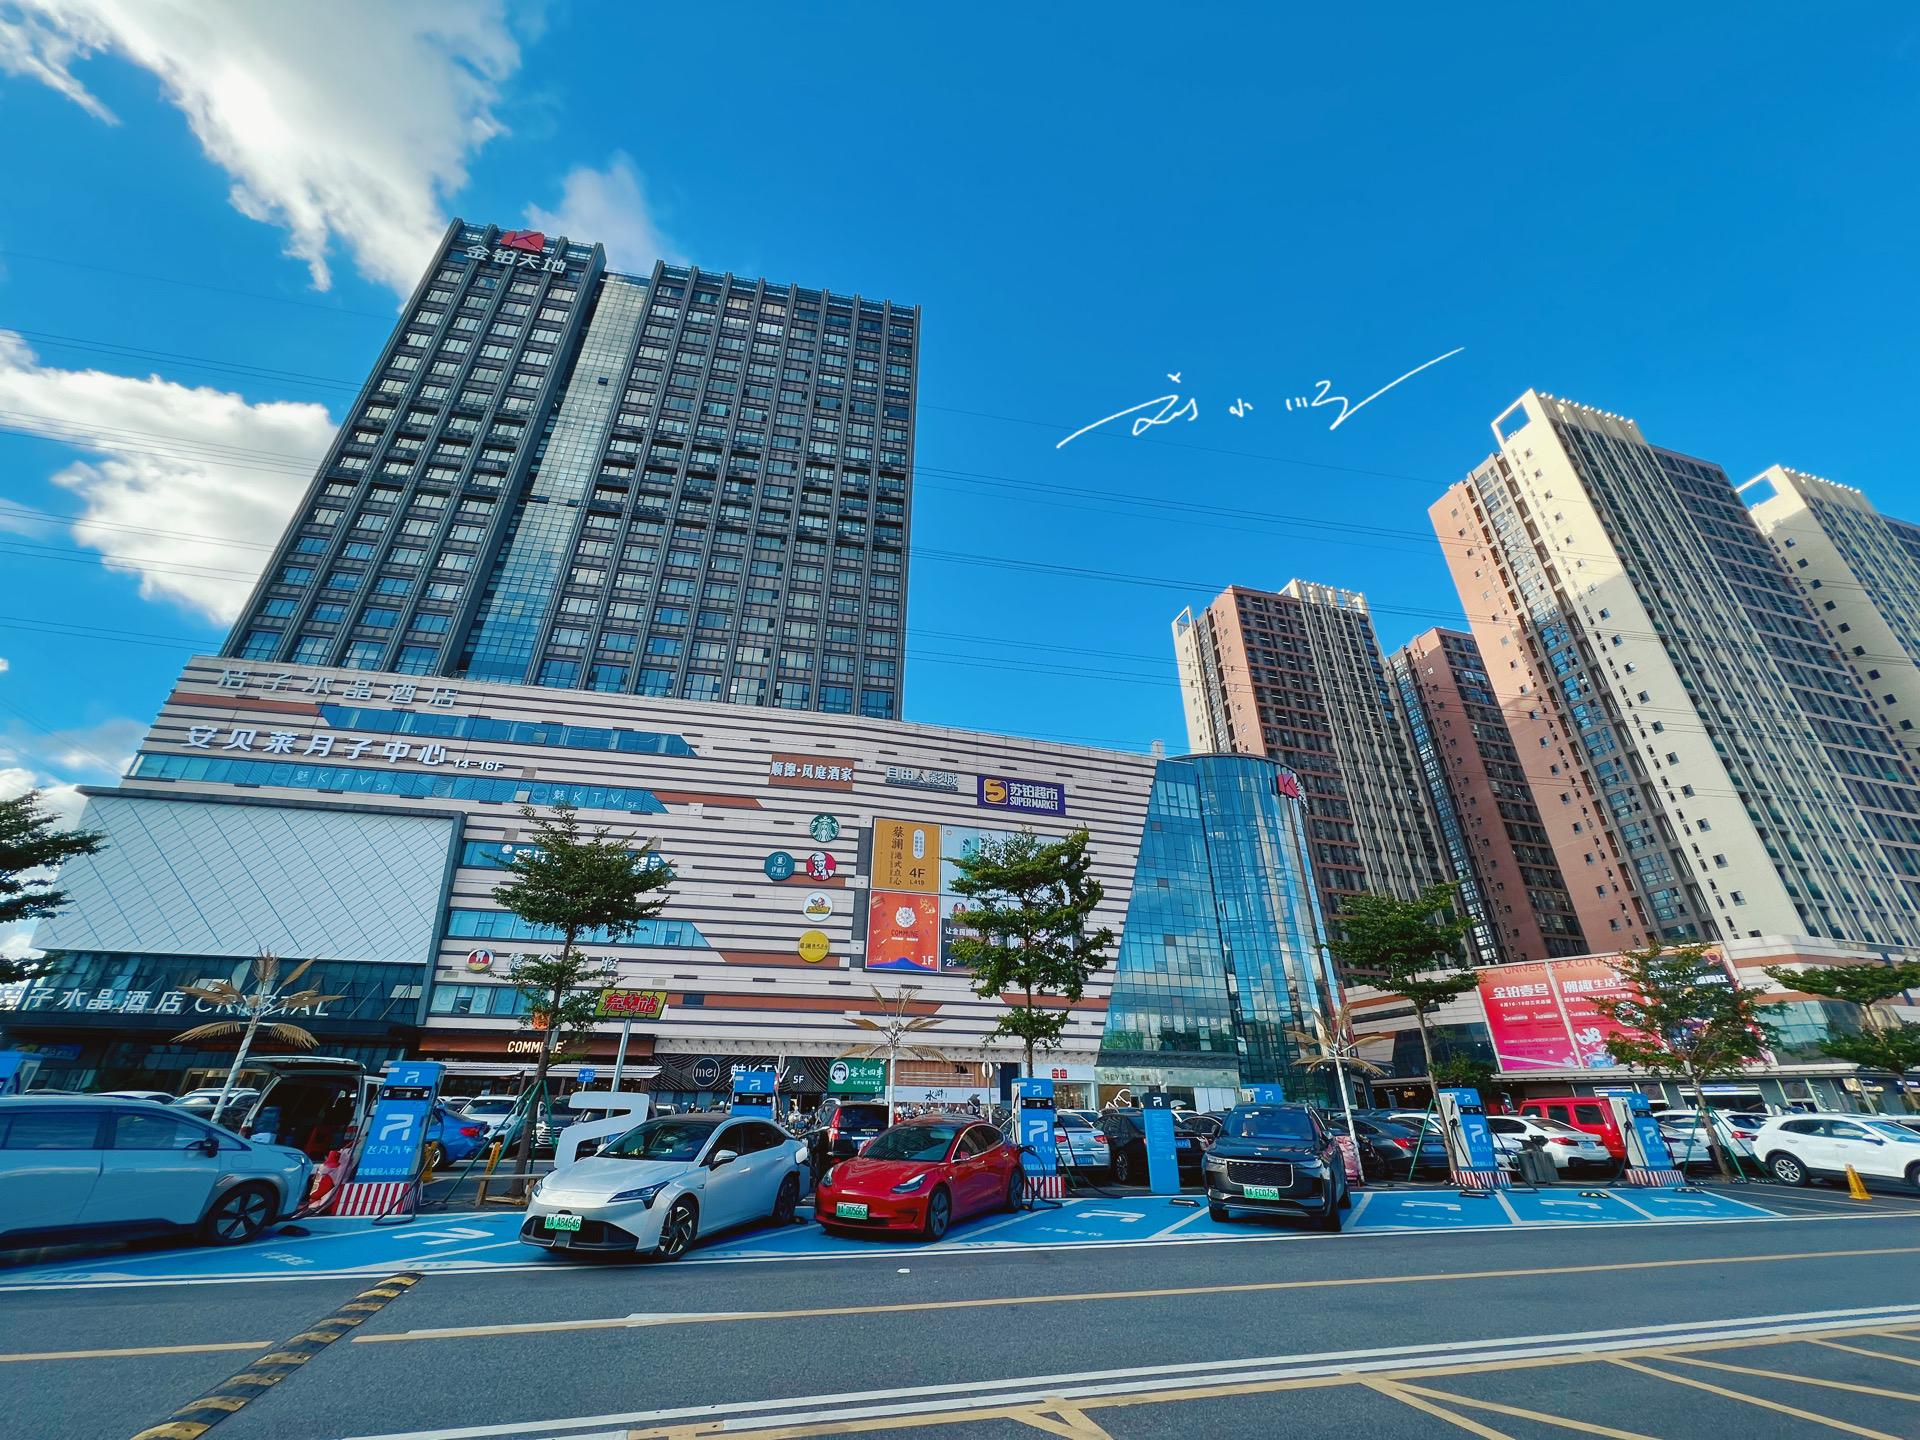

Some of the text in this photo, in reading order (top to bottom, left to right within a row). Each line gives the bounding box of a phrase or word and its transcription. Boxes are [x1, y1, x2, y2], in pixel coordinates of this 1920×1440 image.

[464, 244, 567, 274] 金铂天地
[216, 668, 459, 709] 桔子水晶酒店
[180, 725, 505, 772] 安贝莱月子中心 14-16F
[909, 867, 926, 878] 4F
[921, 955, 934, 966] 1F
[507, 1040, 564, 1054] COMME
